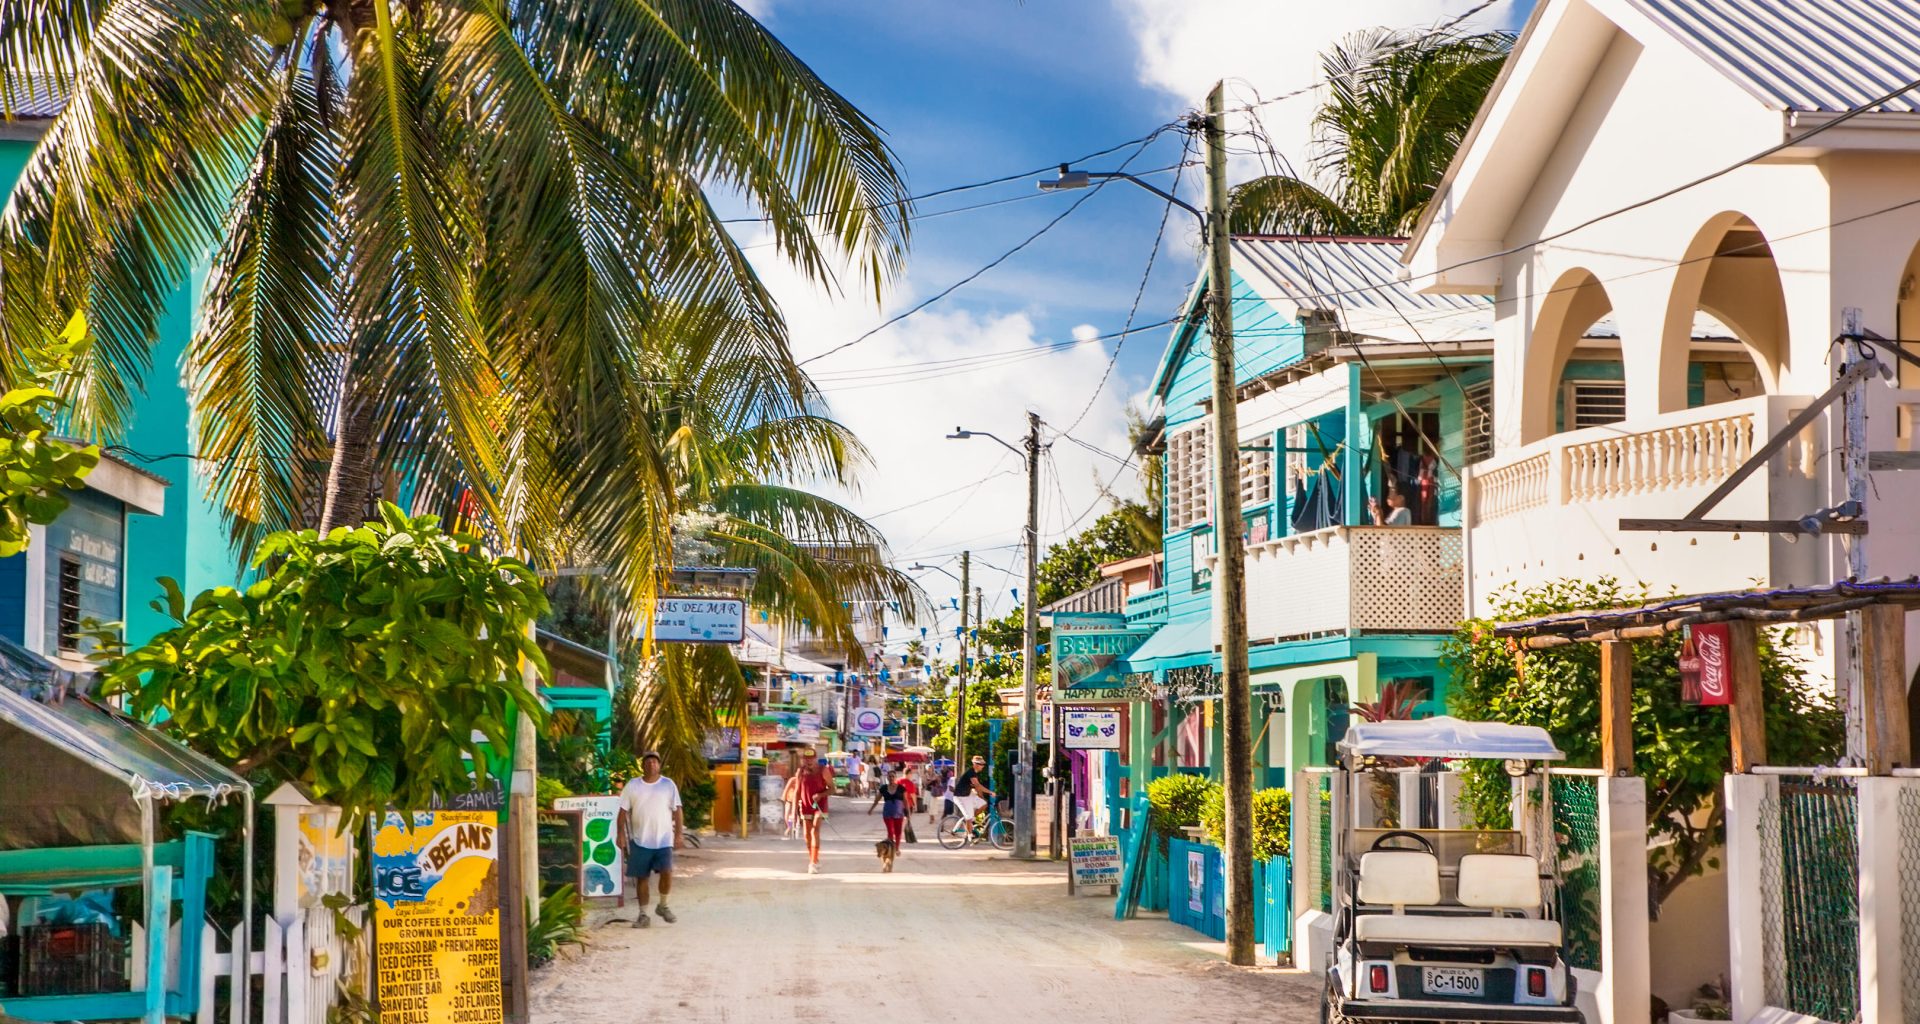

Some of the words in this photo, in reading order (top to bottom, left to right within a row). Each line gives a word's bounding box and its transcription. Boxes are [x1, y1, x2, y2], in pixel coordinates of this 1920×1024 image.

[657, 602, 678, 613] SAS
[682, 603, 703, 613] DEL
[707, 603, 739, 615] MAR
[1064, 689, 1097, 699] HAPPY
[456, 791, 505, 809] SAMPLE
[560, 800, 598, 809] Manatee
[377, 866, 423, 896] ICE
[428, 824, 493, 872] BEANS
[383, 919, 403, 928] OUR
[405, 918, 440, 927] COFFEE
[443, 918, 451, 926] IS
[454, 917, 493, 926] ORGANIC
[399, 929, 432, 938] GROWN
[434, 928, 443, 937] IN
[446, 927, 477, 937] BELIZE
[379, 941, 421, 955] ESPRESSO
[423, 940, 437, 952] BAR
[445, 939, 474, 952] FRENCH
[475, 939, 498, 951] PRESS
[380, 956, 398, 969] ICED
[400, 954, 433, 968] COFFEE
[468, 953, 498, 966] FRAPPE
[380, 971, 396, 983] TEA
[403, 969, 422, 982] ICED
[424, 968, 440, 980] TEA
[479, 967, 499, 979] CHAI
[1435, 975, 1479, 990] C-1500
[381, 983, 423, 998] SMOOTHIE
[425, 982, 442, 994] BAR
[461, 980, 500, 994] SLUSHIES
[381, 998, 413, 1012] SHAVED
[414, 997, 428, 1009] ICE
[454, 996, 464, 1008] 30
[467, 994, 500, 1008] FLAVORS
[403, 1010, 429, 1024] BALLS
[453, 1008, 501, 1023] CHOCOLATES
